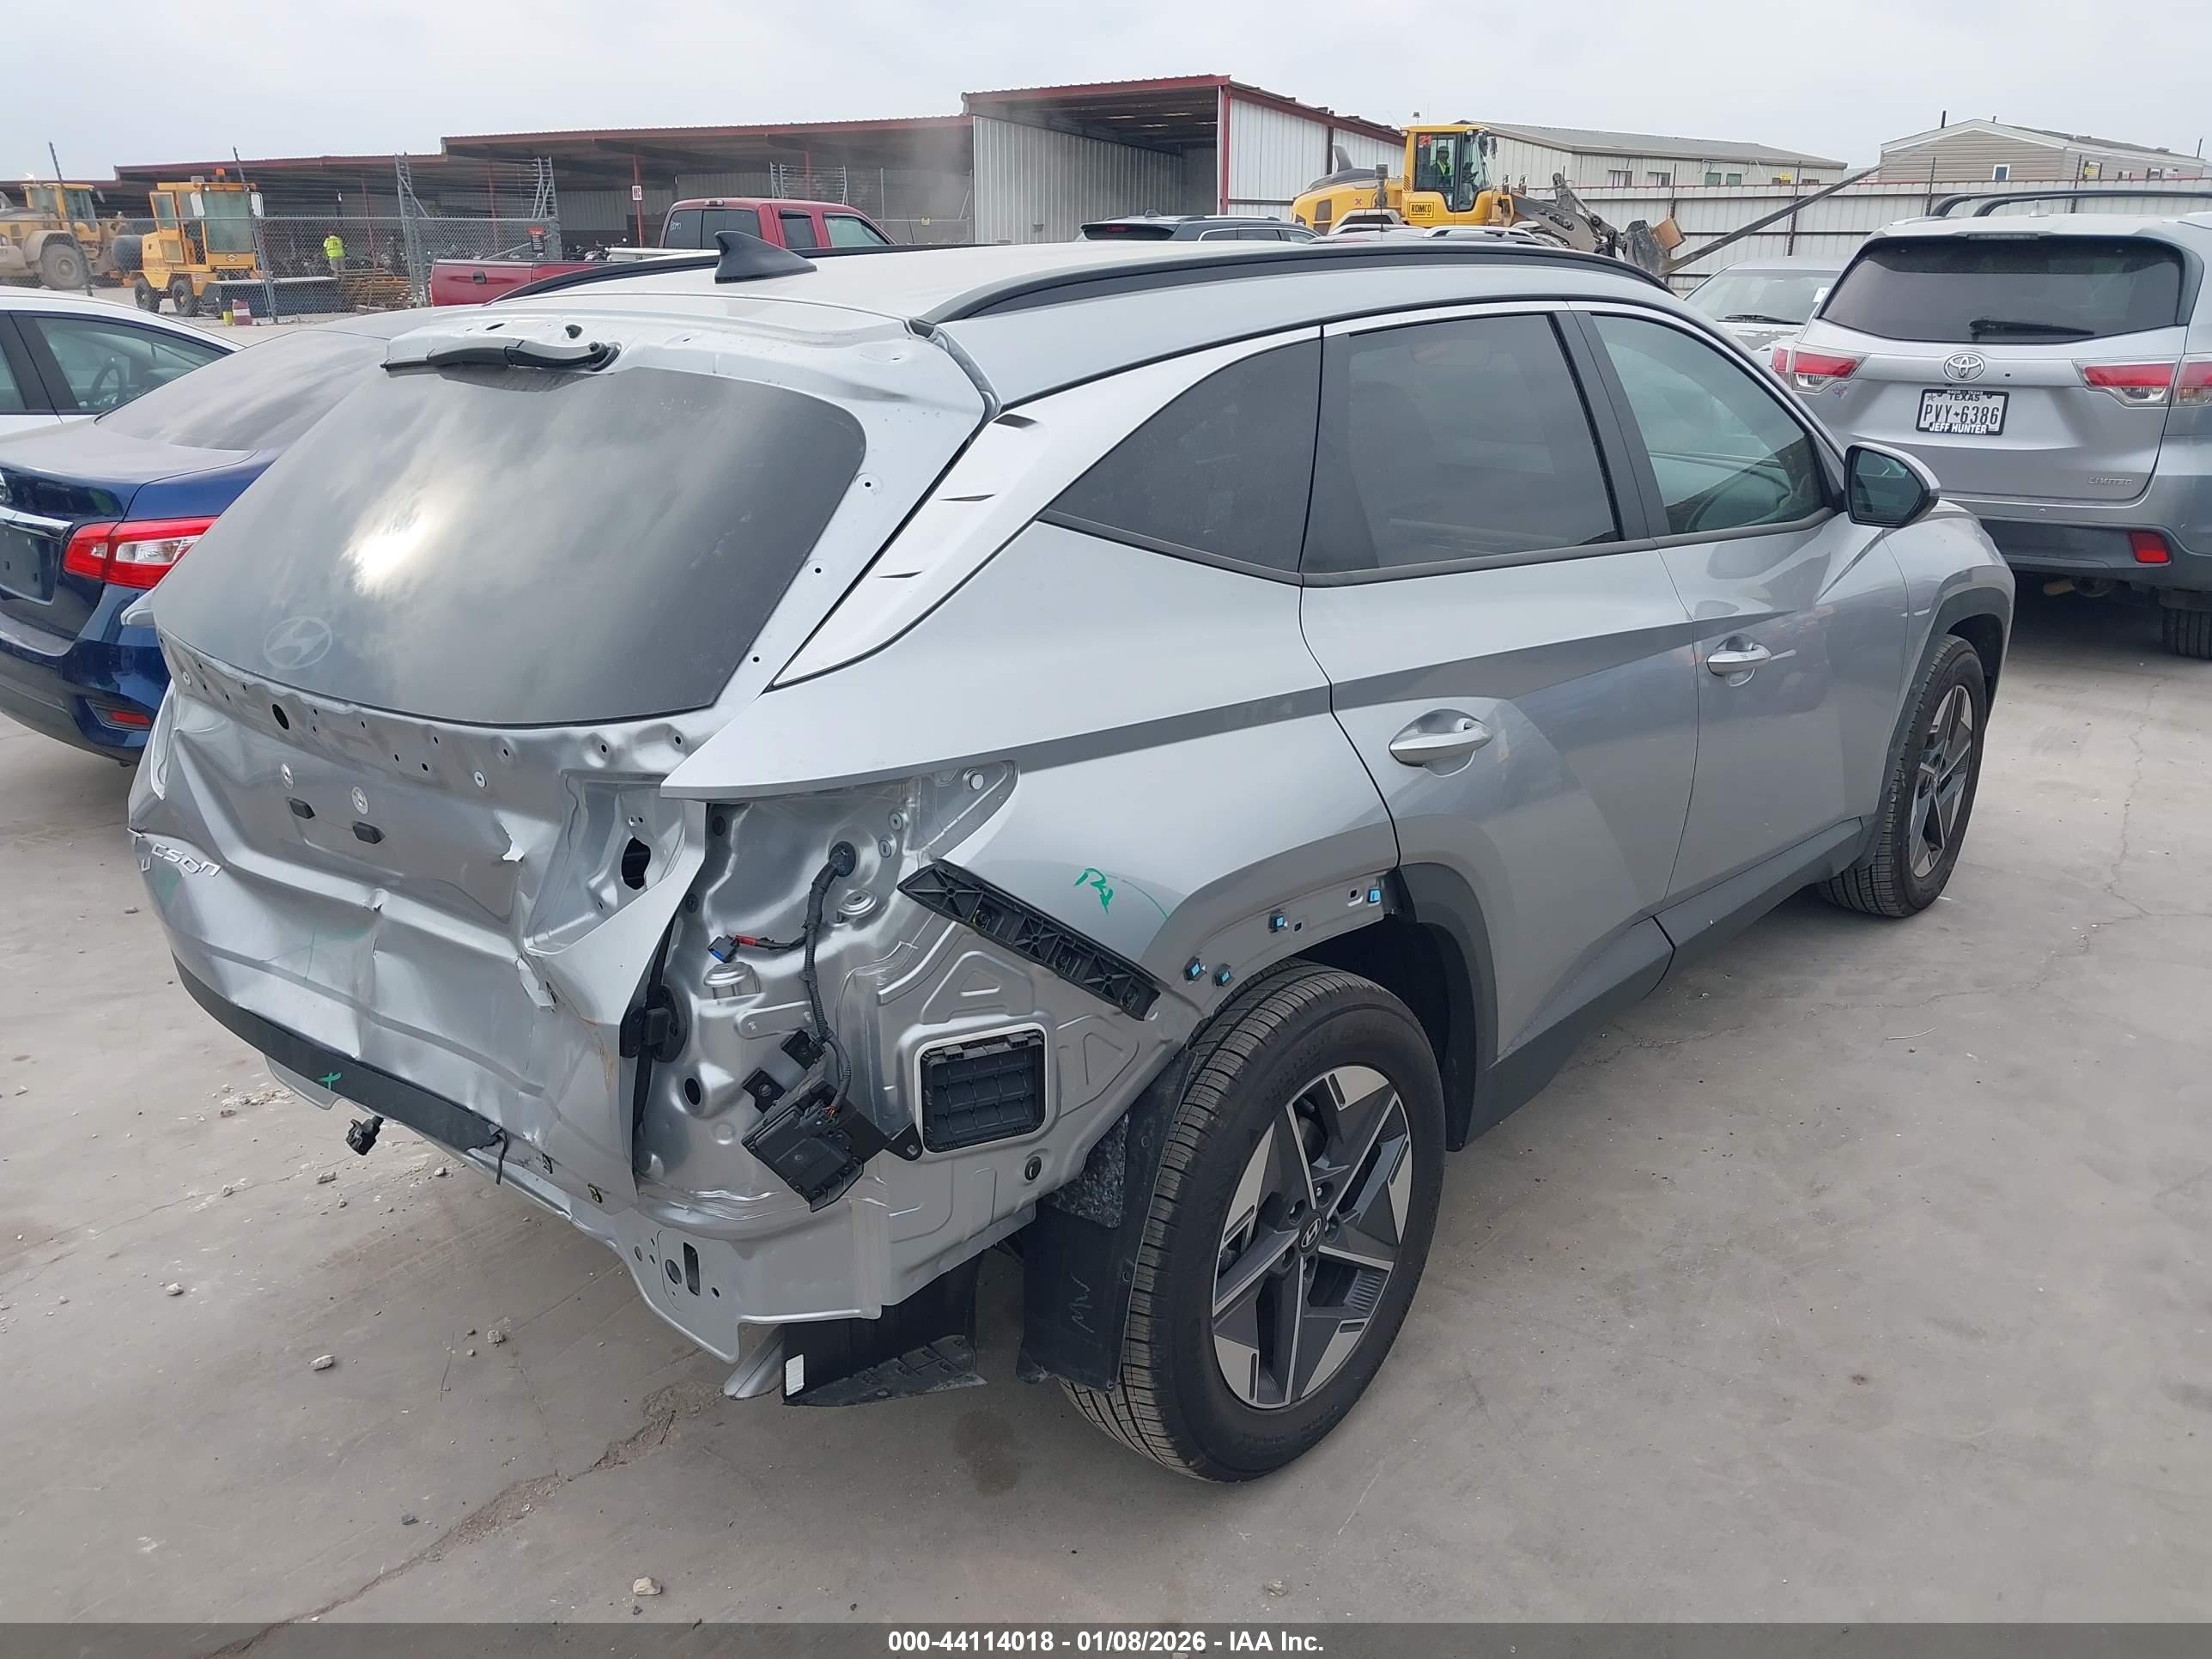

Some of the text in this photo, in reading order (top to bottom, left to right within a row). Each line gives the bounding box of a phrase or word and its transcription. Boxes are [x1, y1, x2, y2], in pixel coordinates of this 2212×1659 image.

[1411, 204, 1431, 213] ROMCO
[1929, 422, 1987, 434] JEFF HUNTER
